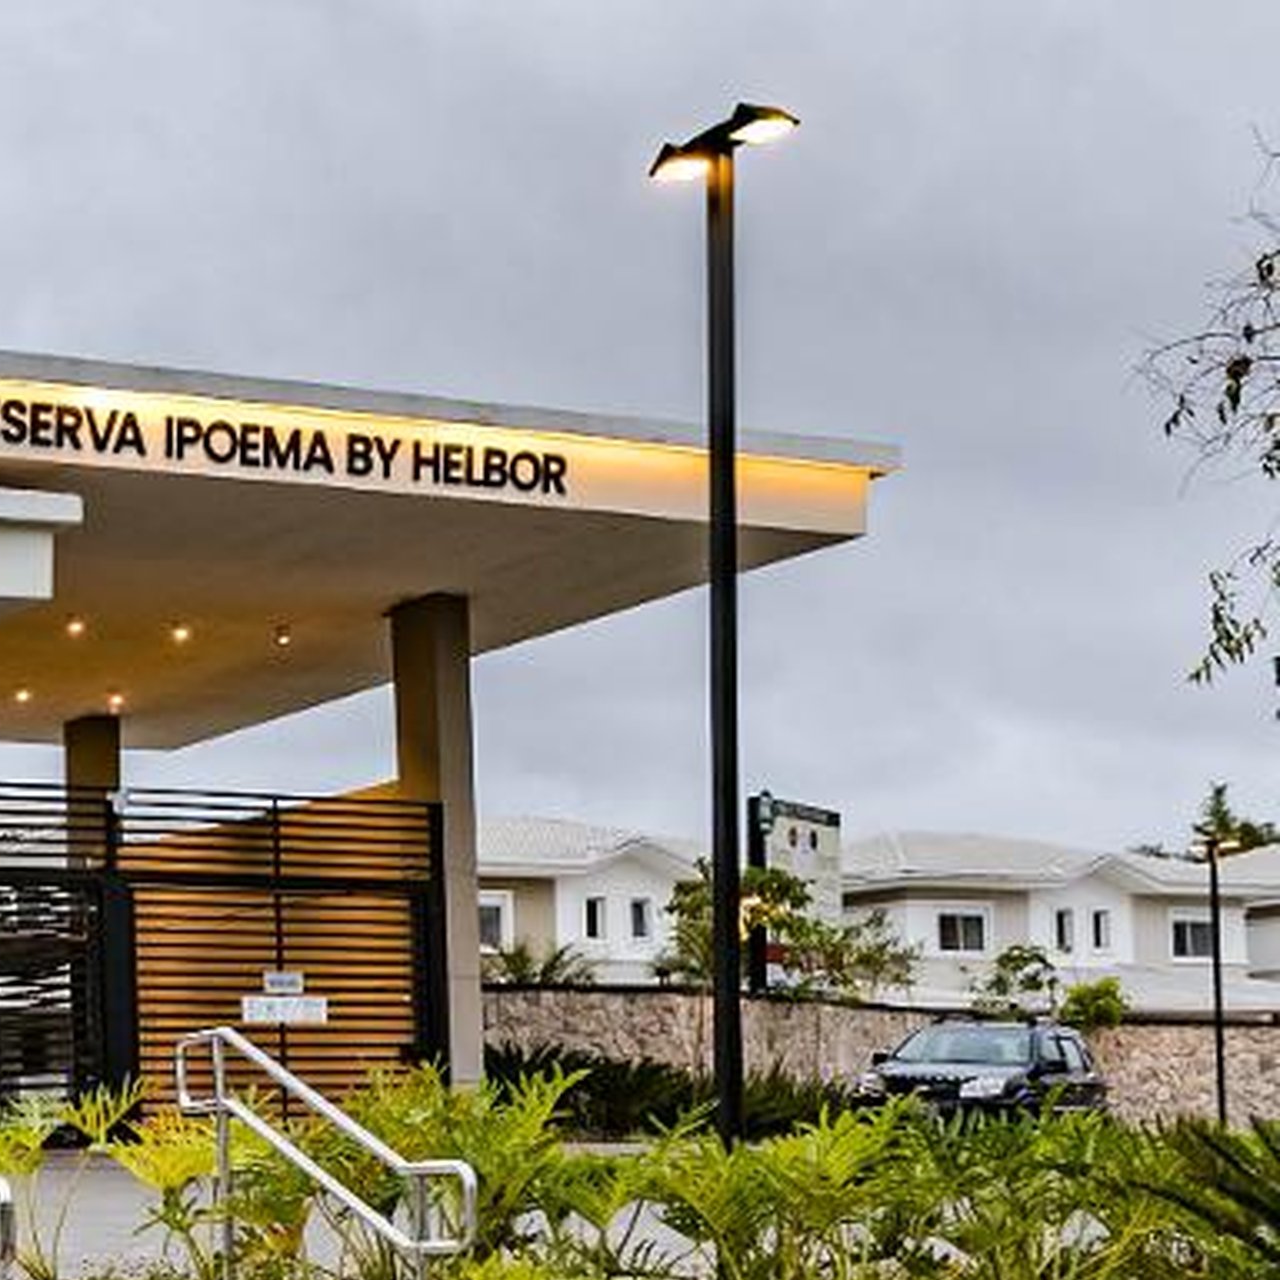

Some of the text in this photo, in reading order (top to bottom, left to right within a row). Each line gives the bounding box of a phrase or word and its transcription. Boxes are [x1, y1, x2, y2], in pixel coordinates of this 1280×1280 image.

[165, 416, 334, 474] IPOEMA
[347, 433, 401, 479] BY
[412, 439, 567, 495] HELBOR
